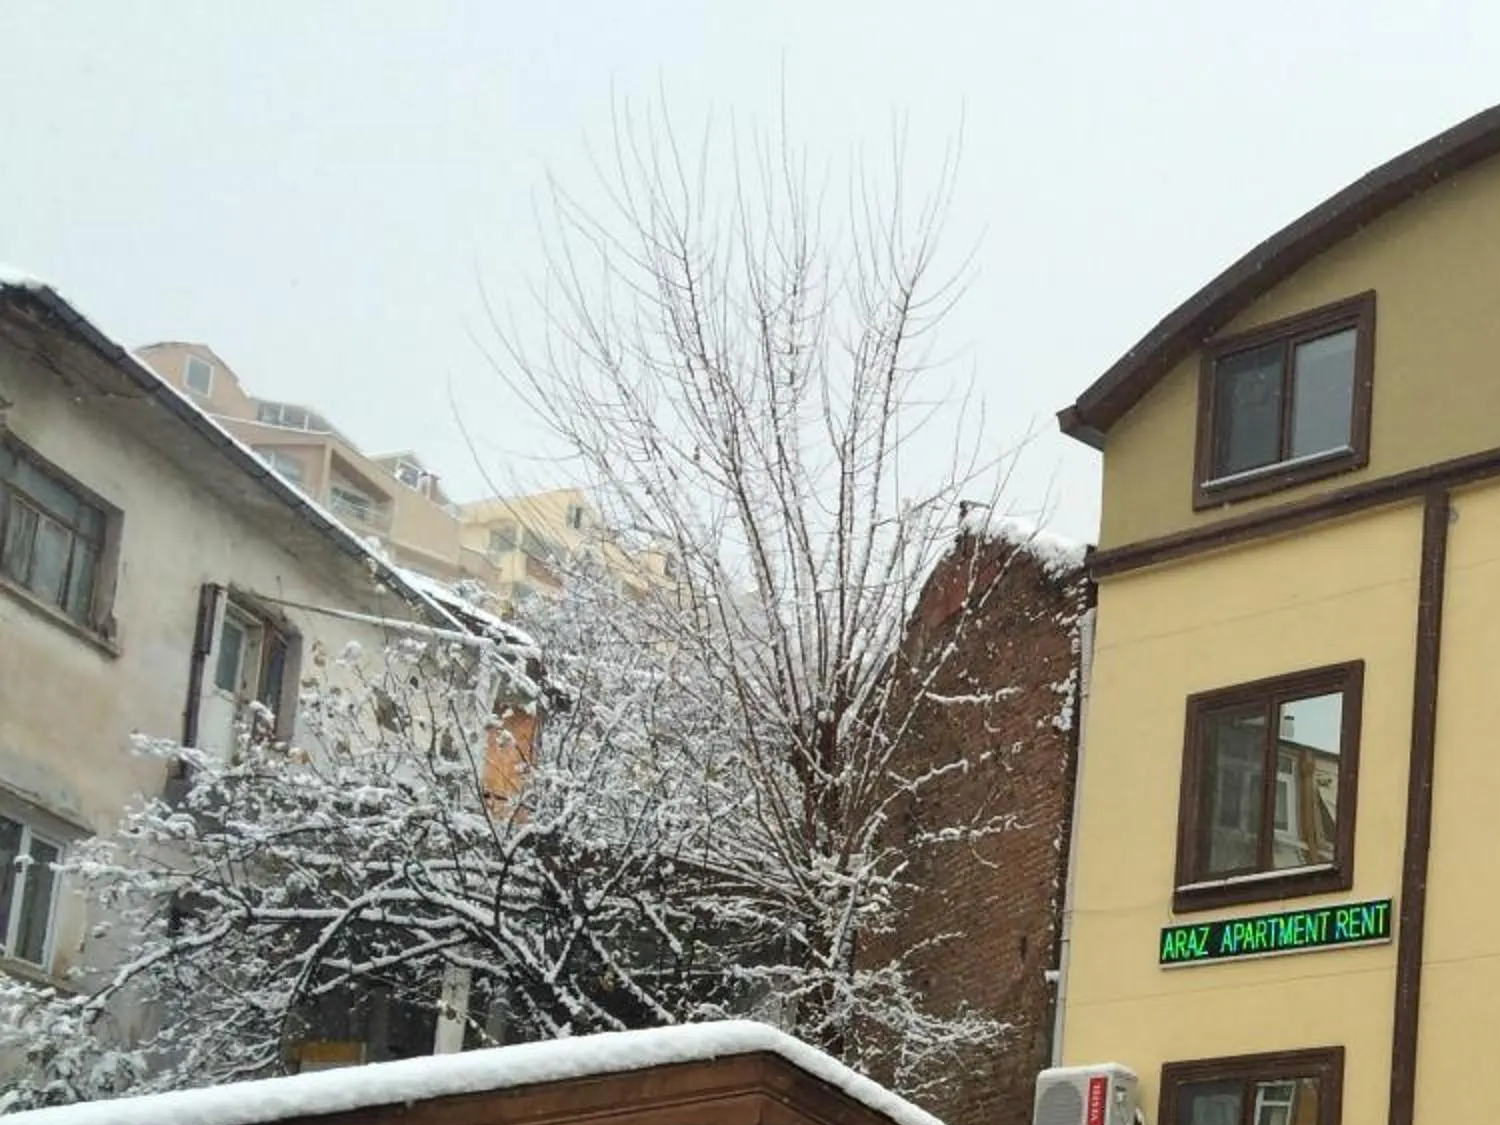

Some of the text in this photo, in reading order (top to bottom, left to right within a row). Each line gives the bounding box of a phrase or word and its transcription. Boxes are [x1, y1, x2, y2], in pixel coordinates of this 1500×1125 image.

[1162, 903, 1389, 961] ARAZ APARTMENT RENT
